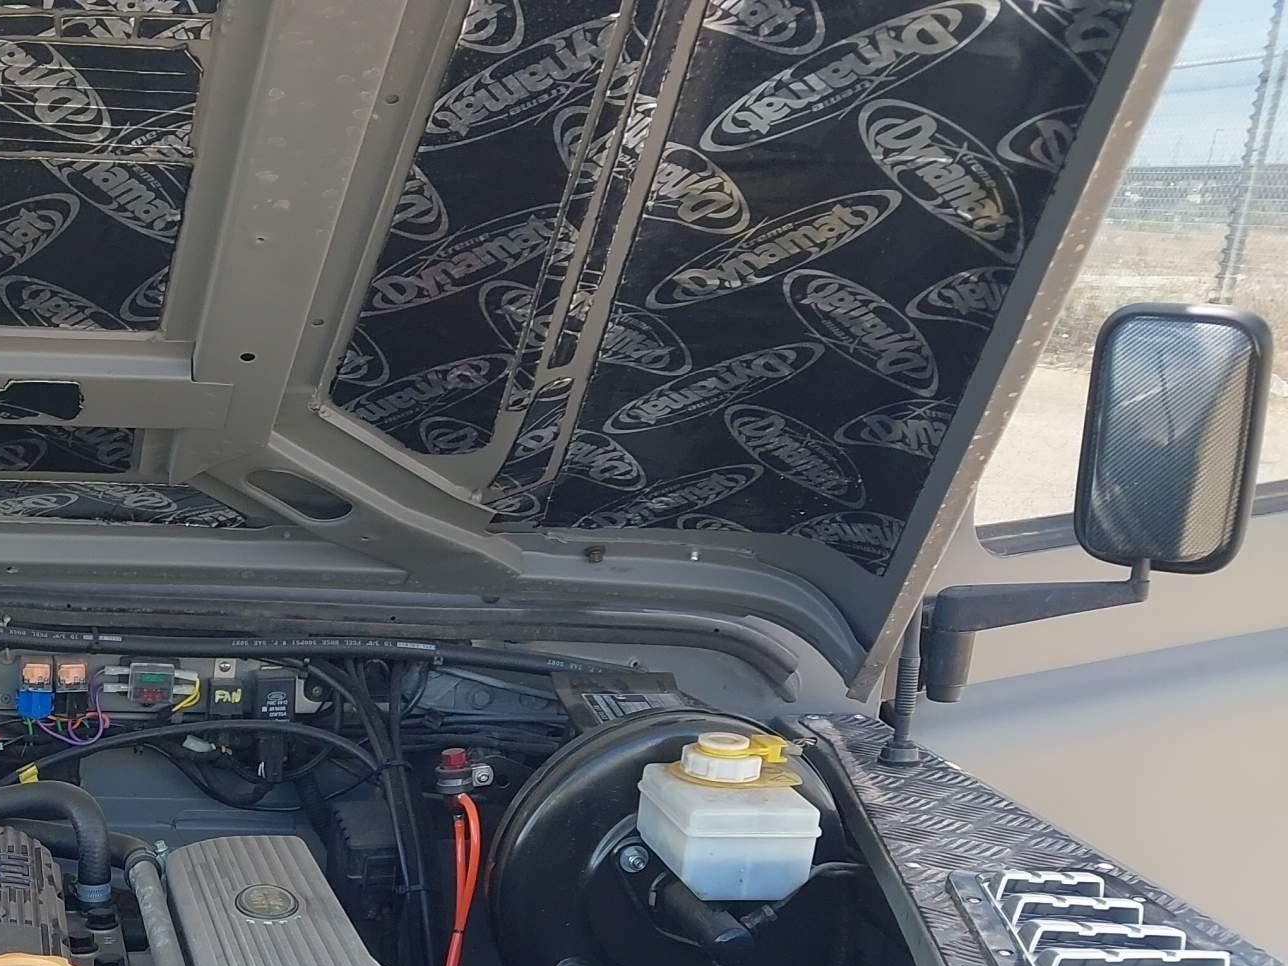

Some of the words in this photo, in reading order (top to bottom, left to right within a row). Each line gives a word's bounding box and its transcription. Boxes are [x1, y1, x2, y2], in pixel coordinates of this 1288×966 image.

[735, 15, 959, 136] Dynamat
[876, 114, 1014, 234] Dynamat
[673, 203, 865, 290] Dynamat
[801, 284, 925, 376] Dynamat
[639, 351, 792, 424] Dynamat
[215, 688, 242, 704] FAN
